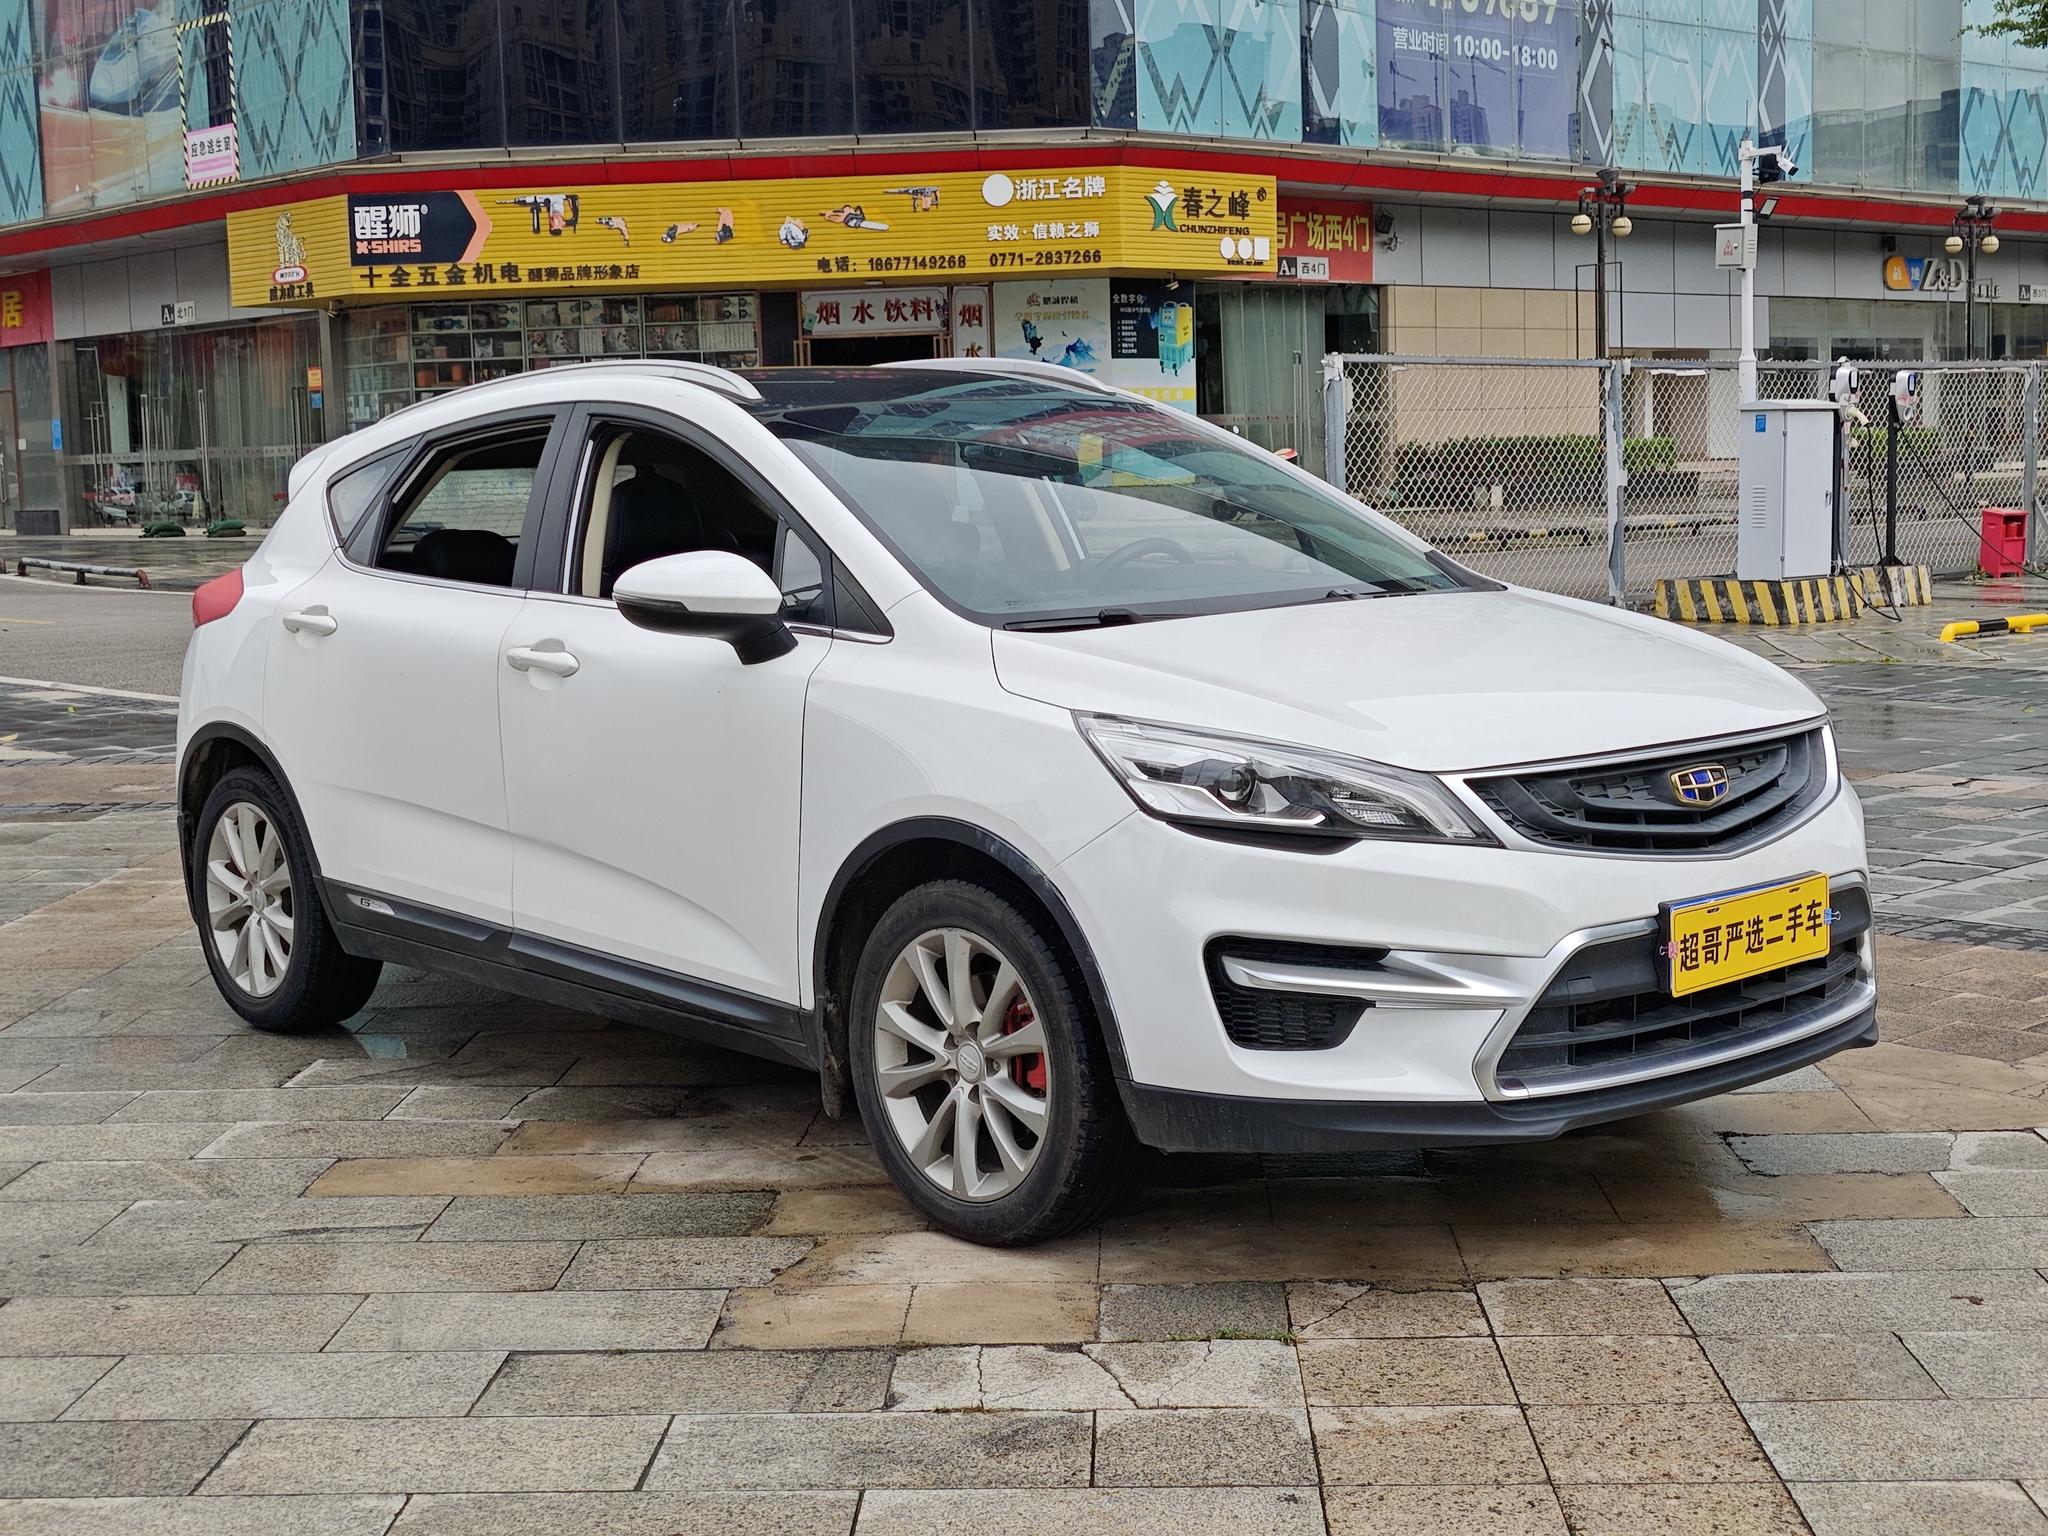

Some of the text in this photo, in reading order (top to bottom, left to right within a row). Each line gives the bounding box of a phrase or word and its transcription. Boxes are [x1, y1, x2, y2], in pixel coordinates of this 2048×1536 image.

[1393, 26, 1557, 70] 营业时间 10:00-18:00
[190, 135, 231, 157] 应急逃生窗
[1015, 175, 1106, 200] 浙江名牌
[1182, 187, 1250, 220] 春之峰
[354, 204, 421, 239] 醒狮
[1180, 224, 1250, 235] CHUNZHIFENG
[868, 254, 967, 272] 18677149268
[990, 250, 1101, 266] 0771-2837266
[1301, 262, 1326, 276] 西4门
[360, 261, 640, 288] 十全五金机电 醒狮品牌形象店
[1923, 258, 1966, 290] Z&D
[1, 289, 25, 328] 居
[361, 898, 381, 909] GS
[1679, 899, 1822, 972] 超哥严选二手车
